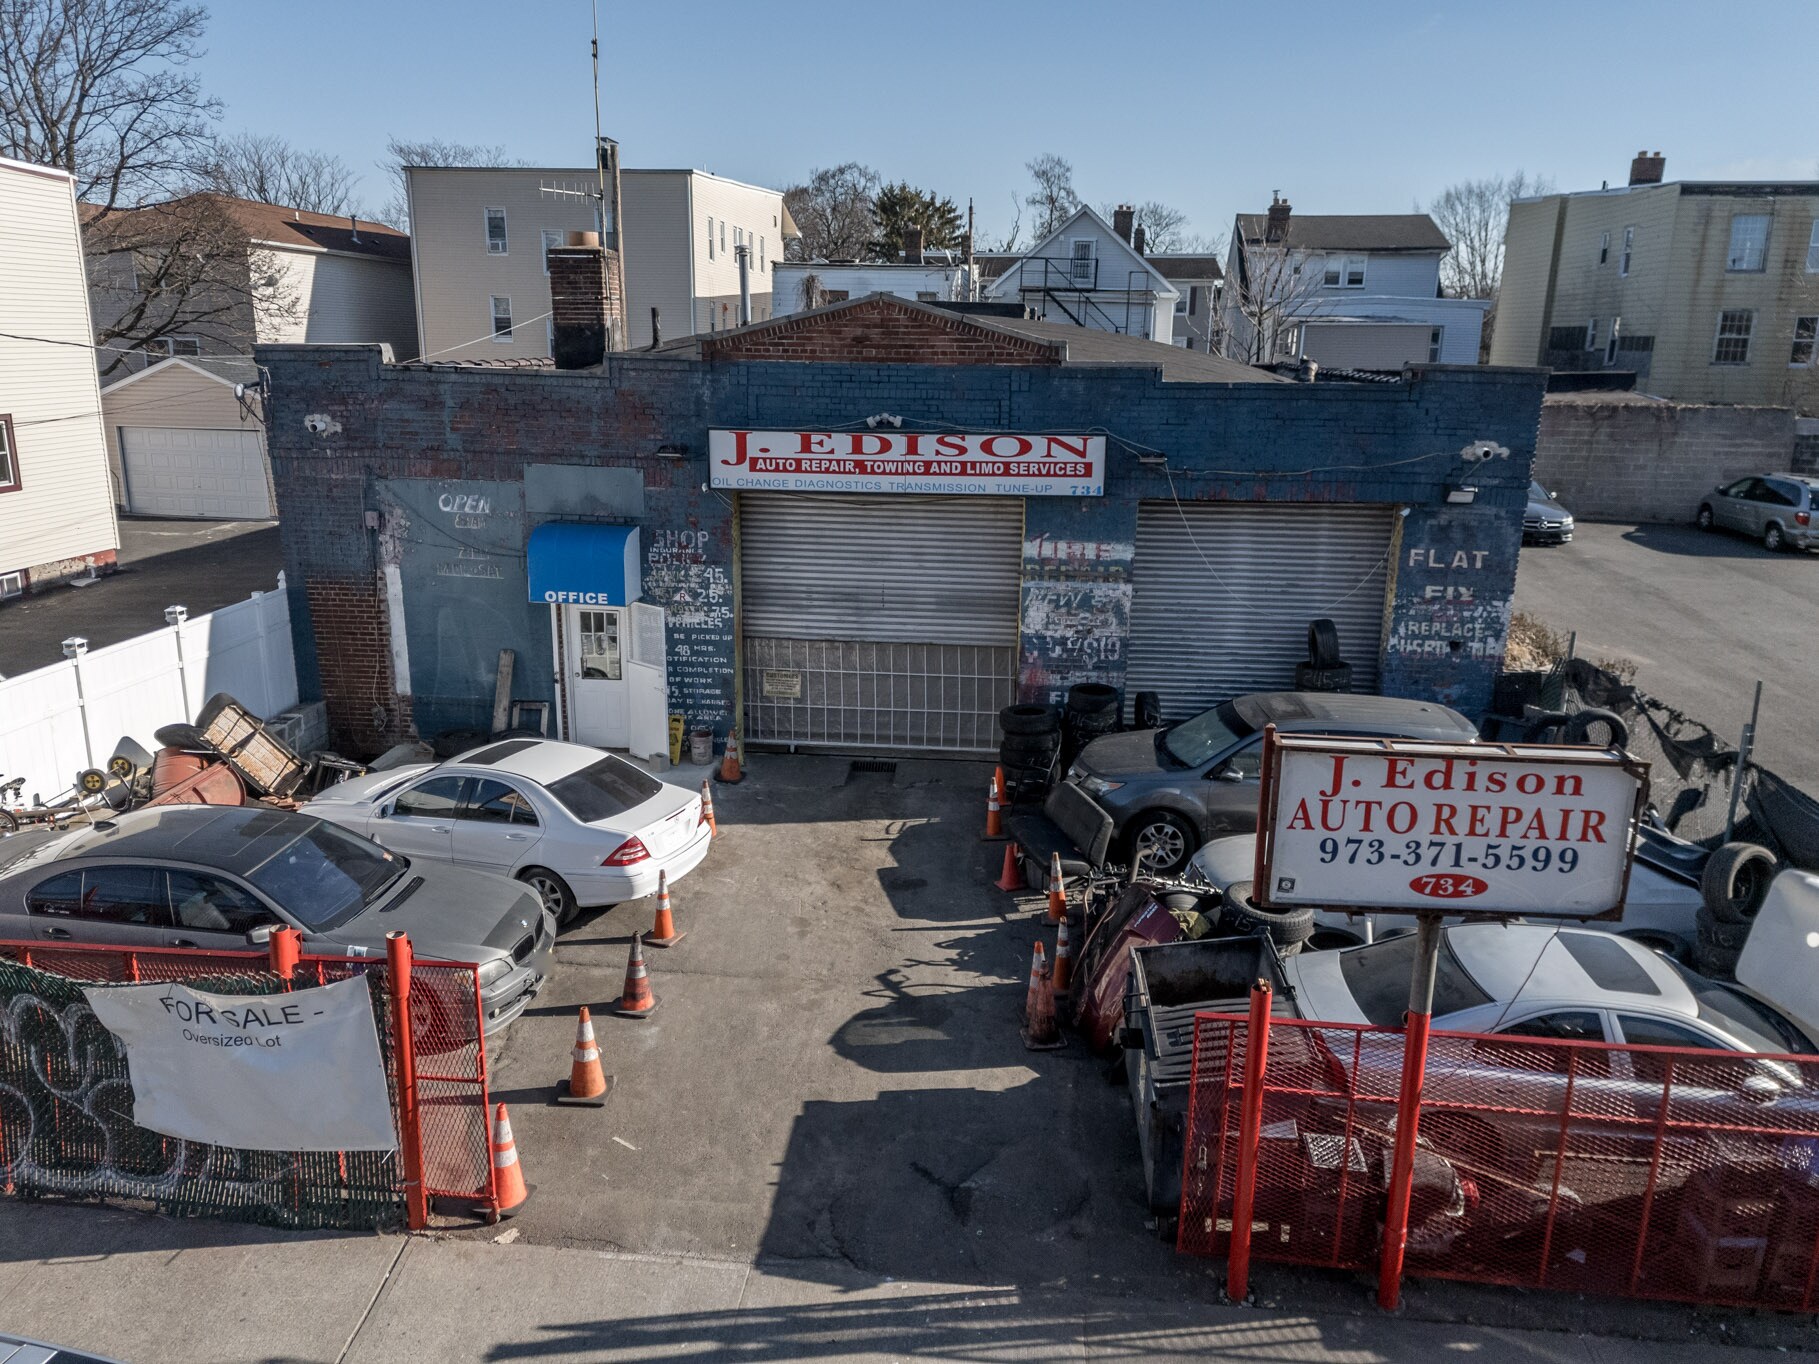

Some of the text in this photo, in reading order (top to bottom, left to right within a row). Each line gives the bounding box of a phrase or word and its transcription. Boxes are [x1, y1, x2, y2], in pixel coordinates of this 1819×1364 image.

[721, 431, 1094, 466] J. EDISON
[756, 459, 1085, 475] AUTO REPAIR, TOWING AND LIMO SERVICES
[712, 477, 1102, 495] OIL CHANGE DIAGNOSTICS TRANSMISSION TUNE-UP 734
[438, 493, 489, 513] OPEN
[654, 530, 709, 548] SHOP
[1408, 549, 1489, 569] FLAT
[544, 590, 608, 604] OFFICE
[1424, 585, 1474, 601] FIX
[1407, 621, 1486, 637] REPLACE
[675, 645, 690, 656] 48
[1319, 755, 1584, 798] J. Edison
[1286, 797, 1607, 843] AUTO REPAIR
[1319, 836, 1579, 874] 973-371-5599
[1421, 877, 1475, 896] 734
[159, 997, 217, 1024] FOR
[220, 1005, 304, 1030] SALE
[182, 1029, 282, 1047] Oversized Lot
